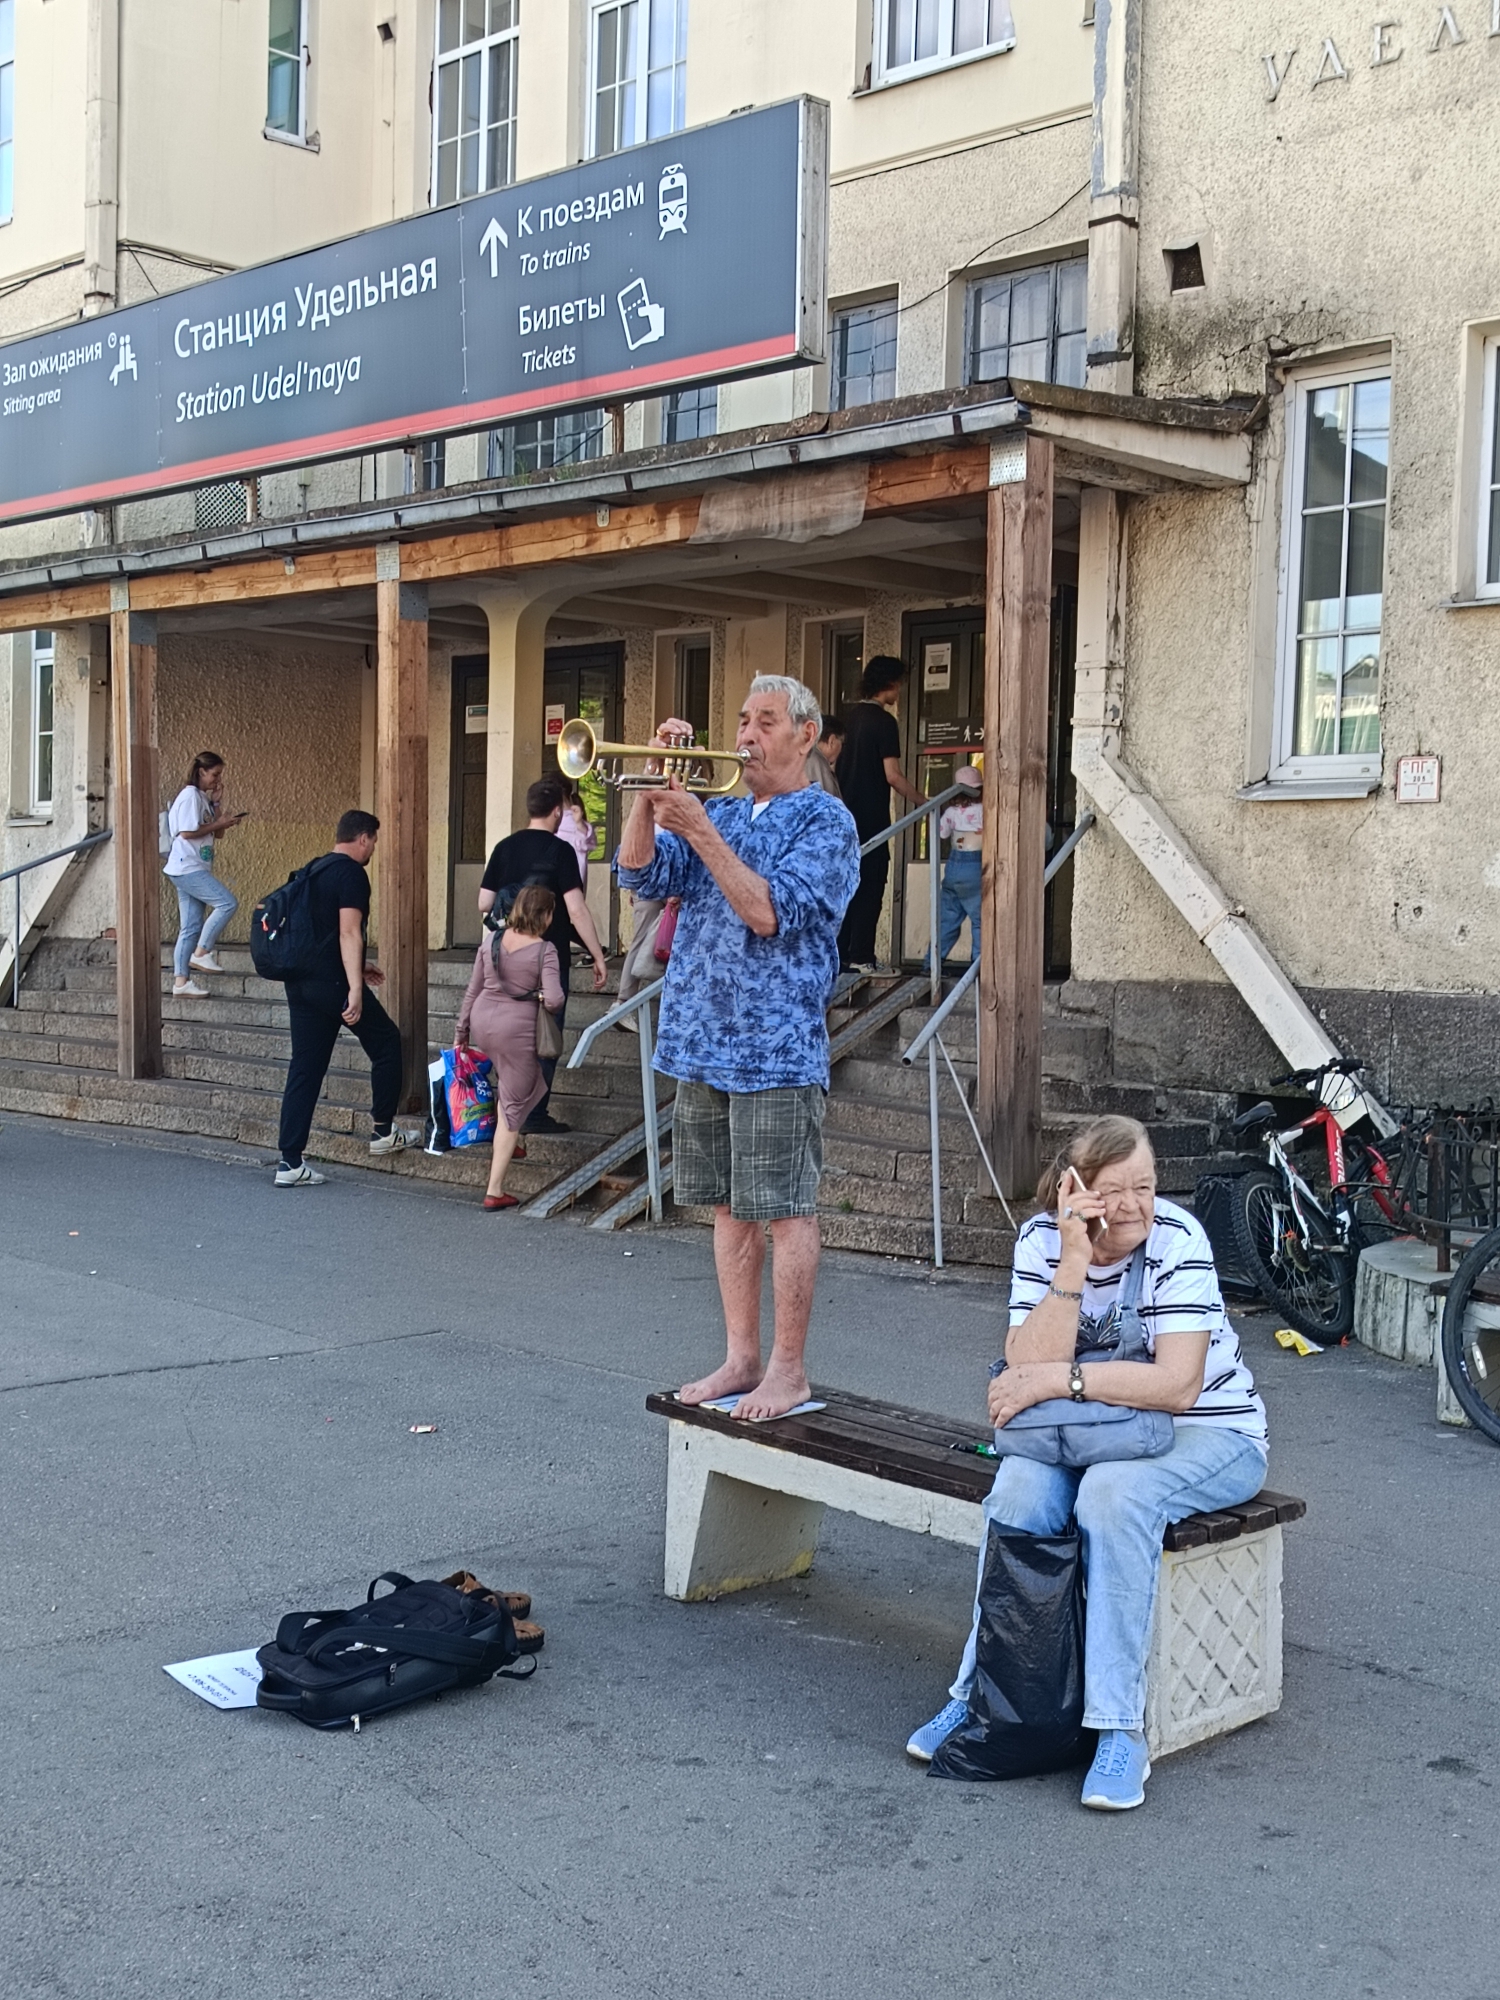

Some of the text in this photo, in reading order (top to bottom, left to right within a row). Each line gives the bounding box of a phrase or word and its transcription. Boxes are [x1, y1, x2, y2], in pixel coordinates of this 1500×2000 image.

[517, 181, 645, 239] К поездам
[520, 241, 591, 277] To trains
[174, 256, 438, 358] Станция Удельная
[519, 294, 606, 336] Билеты
[3, 341, 102, 386] Зал ожидания
[522, 344, 577, 374] Tickets
[3, 388, 61, 416] Sitting area
[175, 355, 361, 423] Station Udel'naya
[1411, 761, 1428, 774] ПГ
